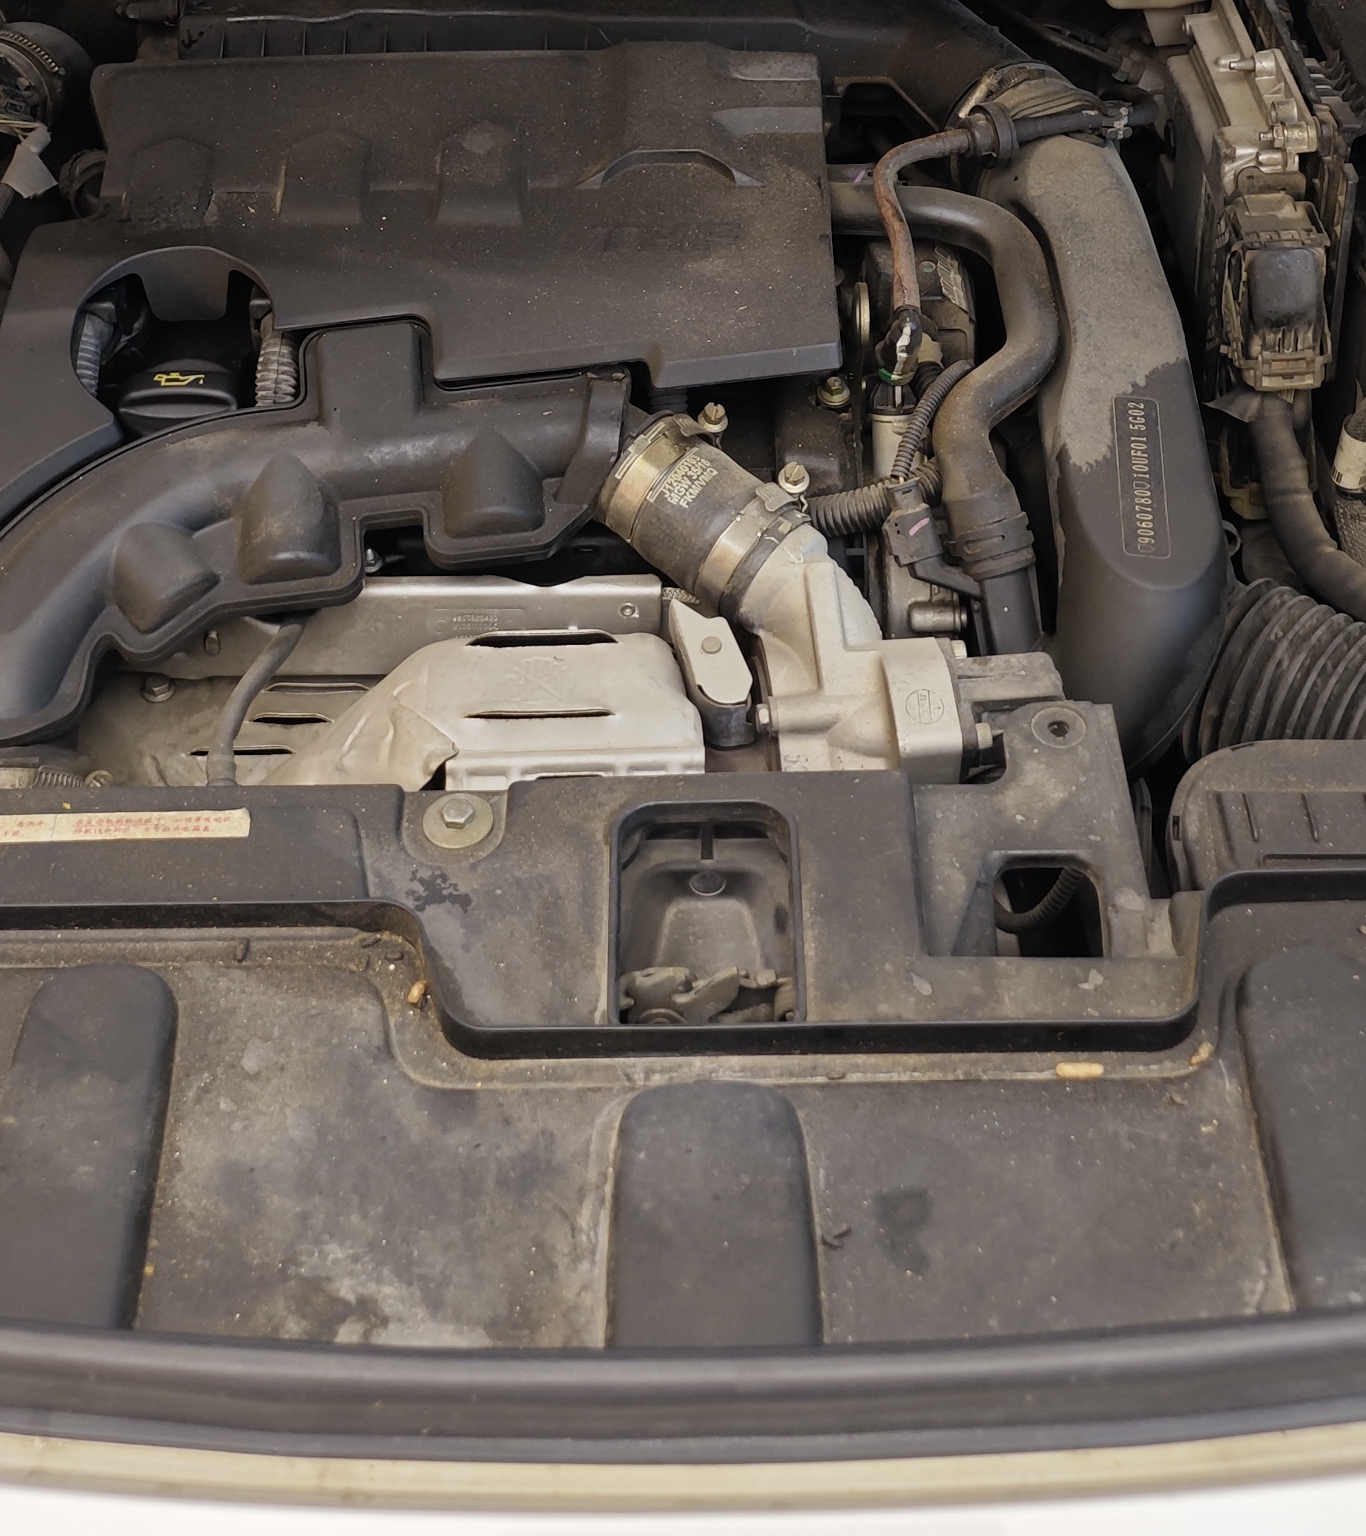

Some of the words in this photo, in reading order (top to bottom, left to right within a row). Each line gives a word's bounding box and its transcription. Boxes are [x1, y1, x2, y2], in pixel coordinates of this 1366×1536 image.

[667, 479, 691, 505] MGW
[687, 459, 710, 479] 35/16
[679, 468, 718, 508] FKM/VMQ
